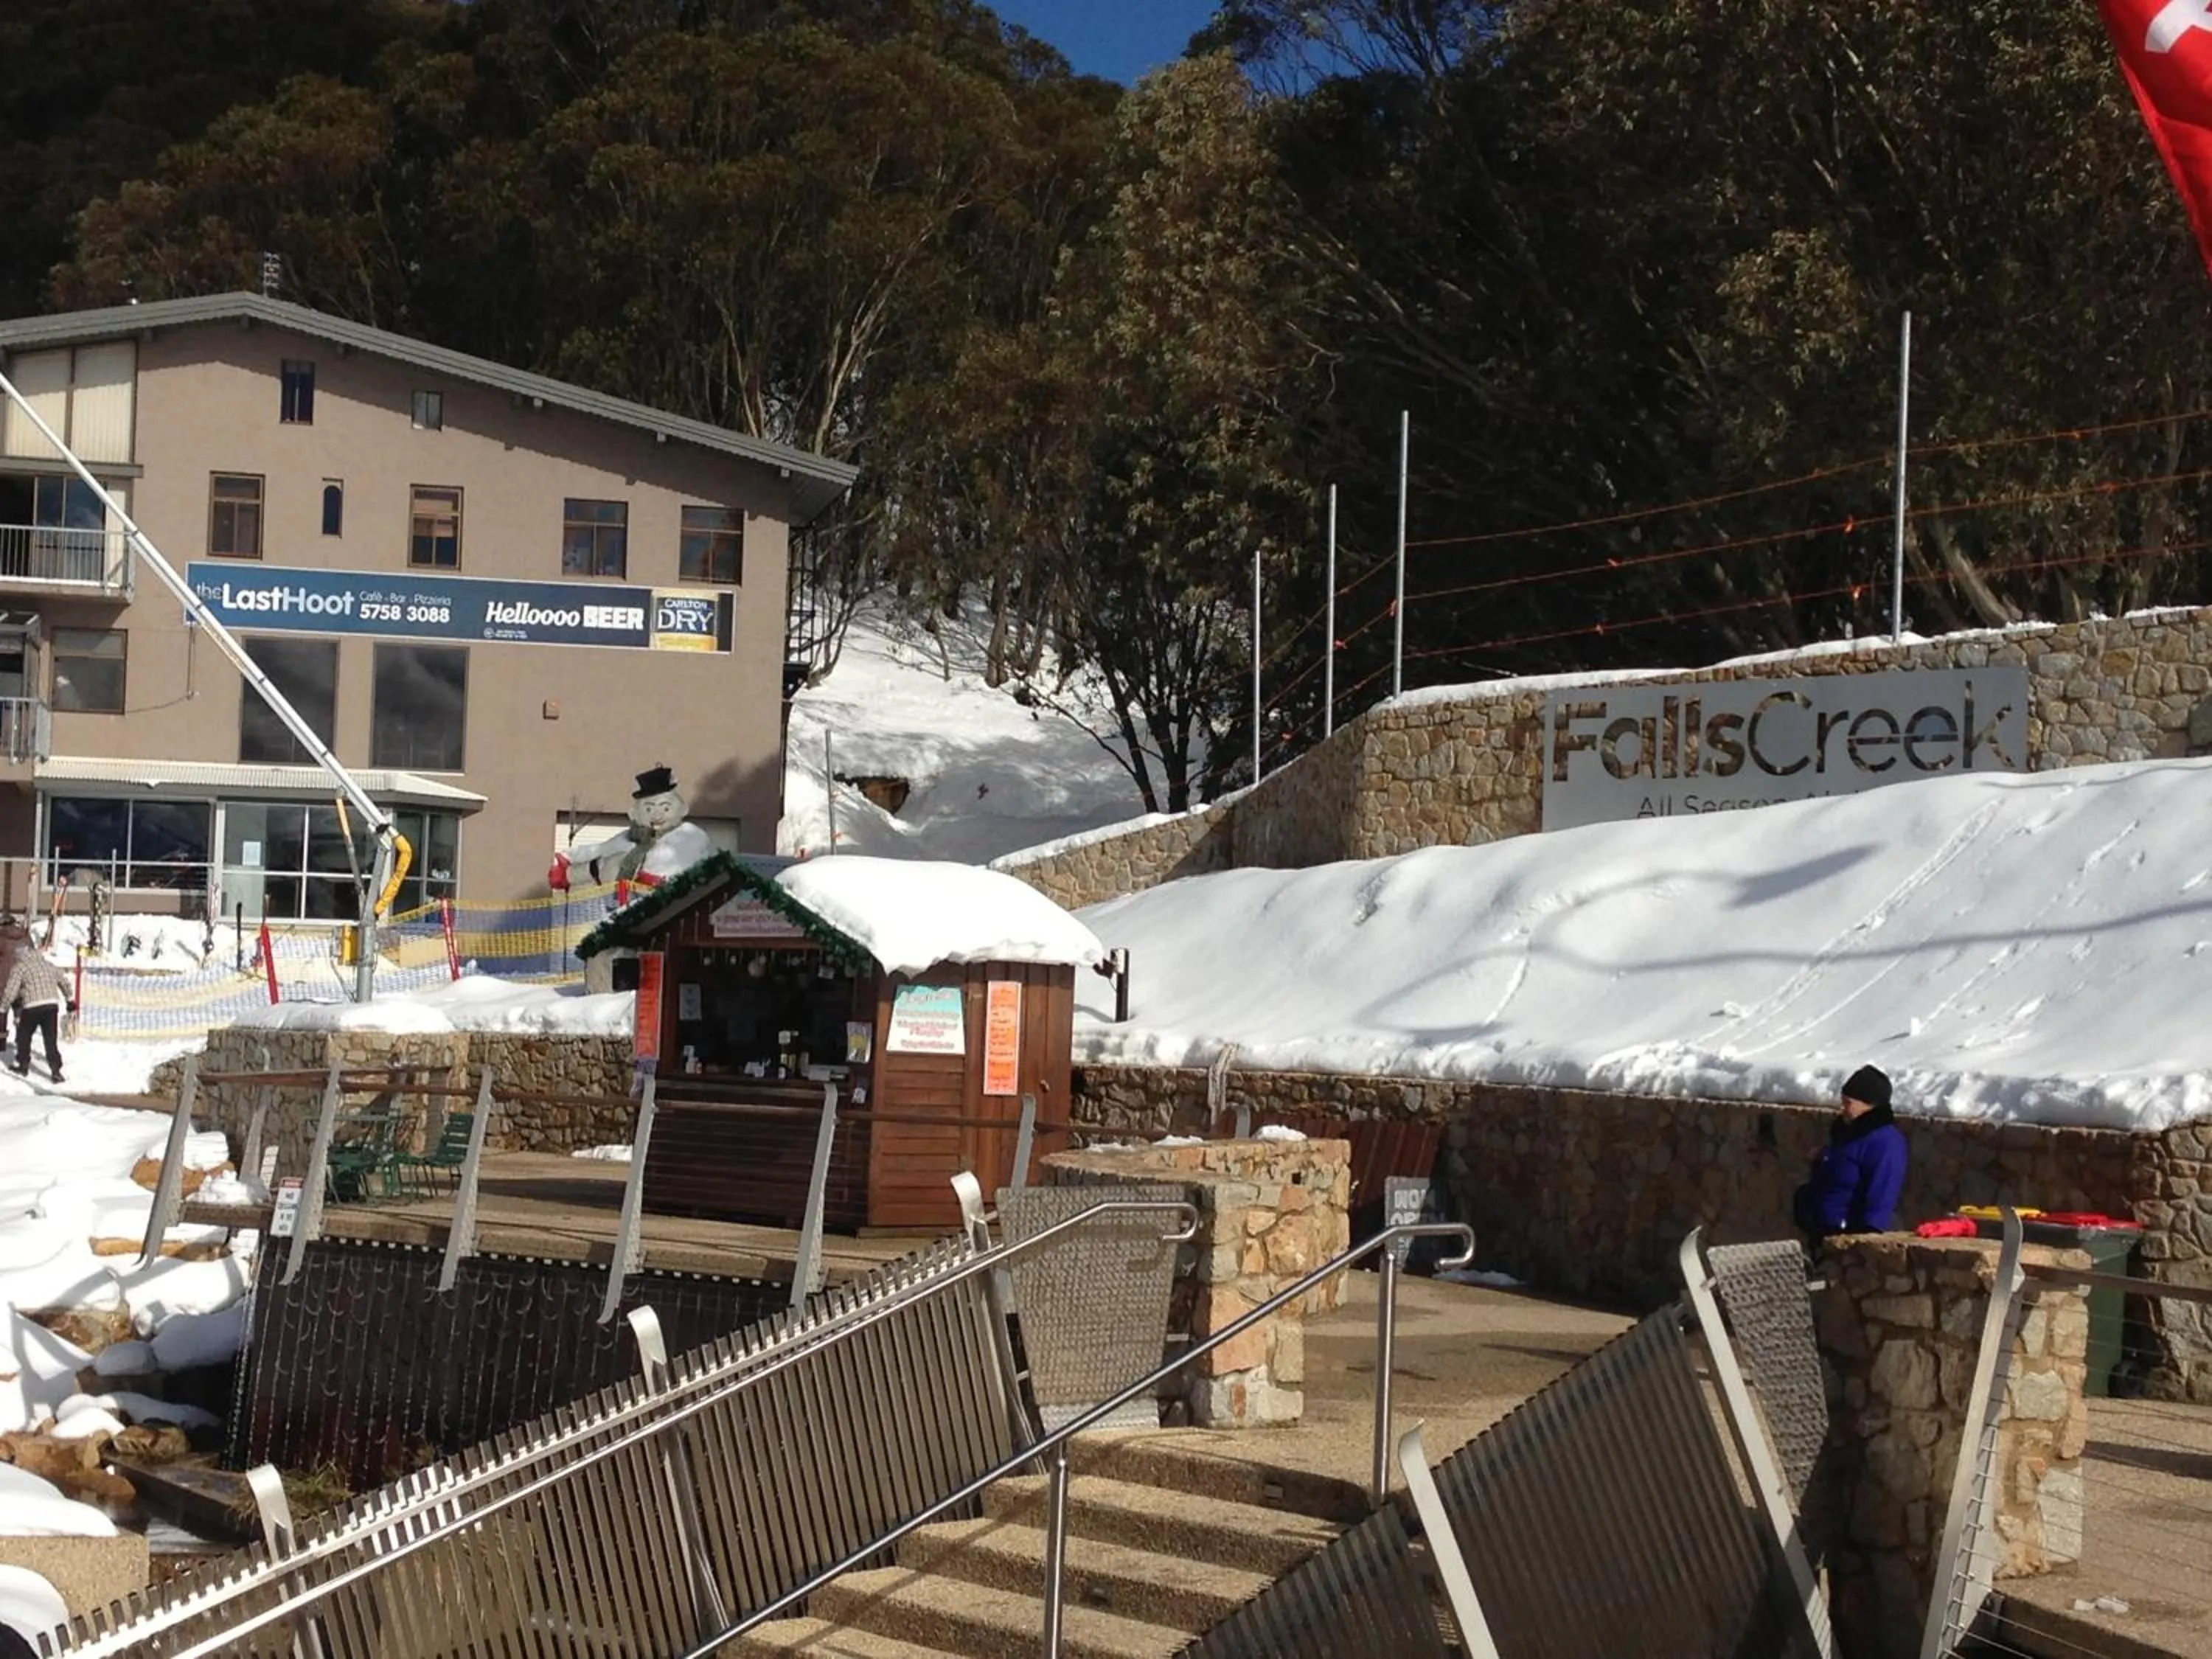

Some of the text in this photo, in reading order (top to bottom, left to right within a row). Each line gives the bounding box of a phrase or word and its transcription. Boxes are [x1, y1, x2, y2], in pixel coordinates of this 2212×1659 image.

[390, 592, 406, 603] Bar
[664, 599, 708, 609] CARLTON
[359, 603, 451, 623] 5758 3088
[485, 601, 644, 630] Helloooo BEER
[658, 608, 714, 631] DRY
[1636, 793, 1672, 819] All
